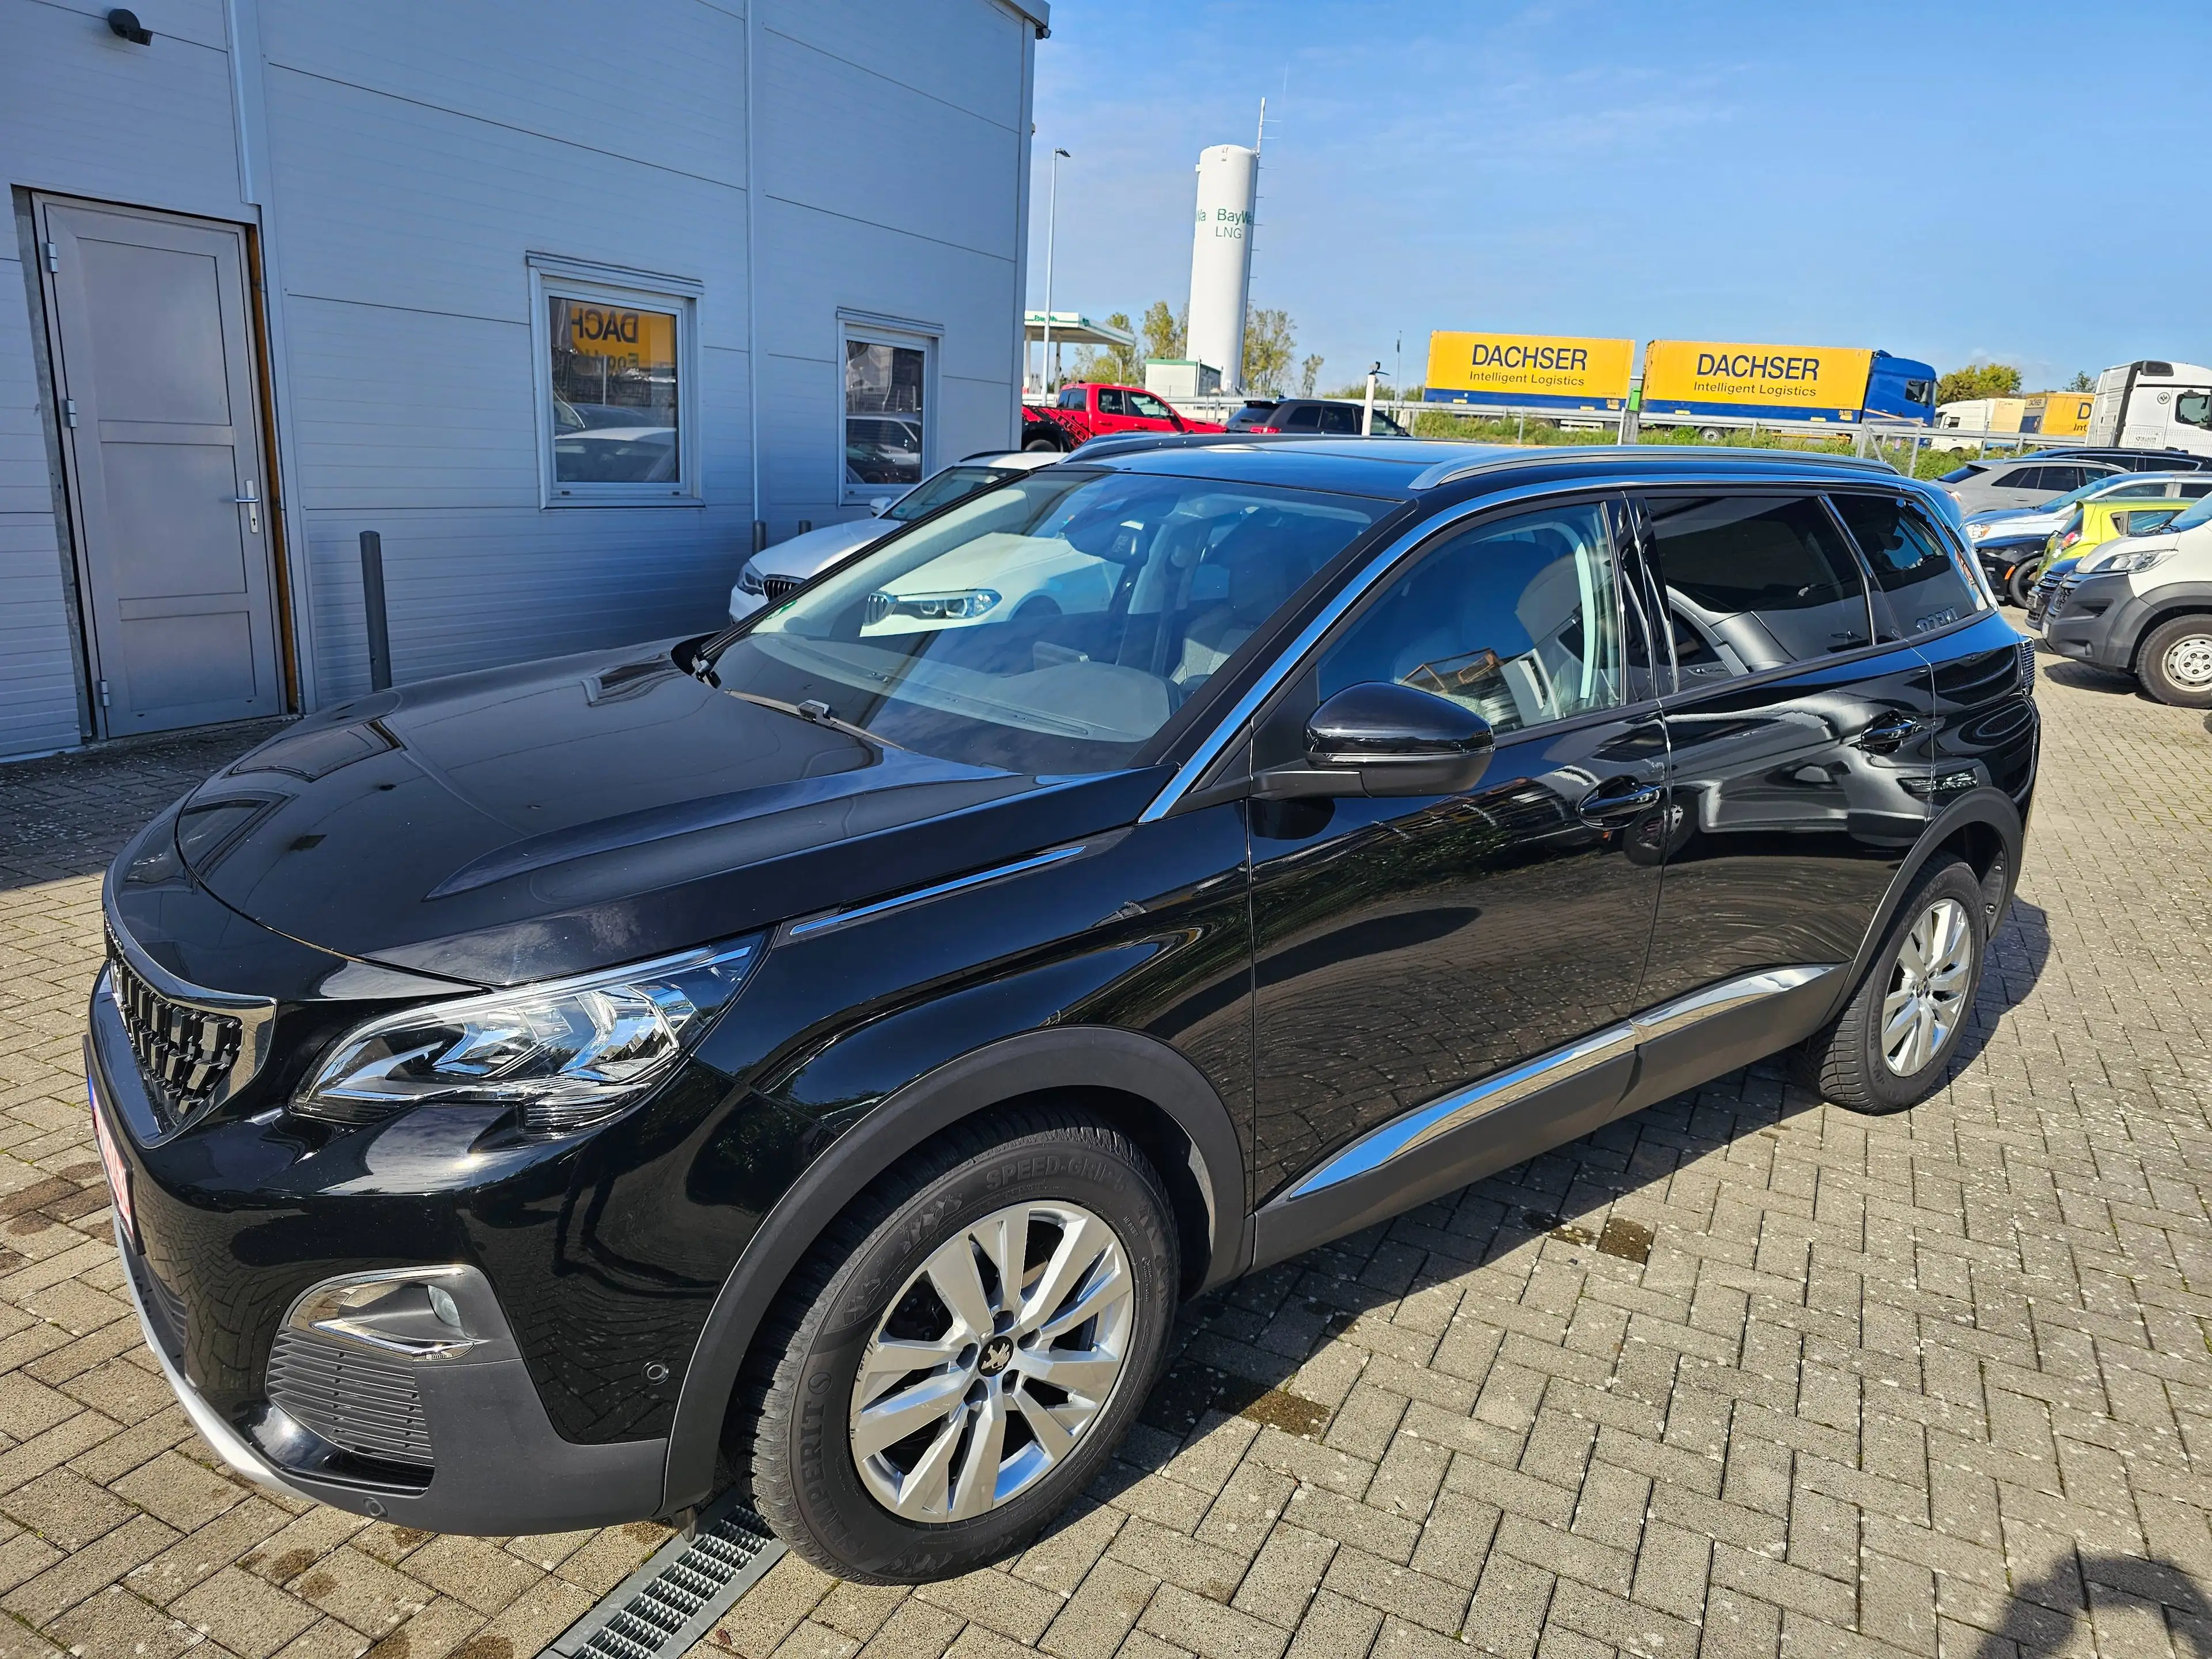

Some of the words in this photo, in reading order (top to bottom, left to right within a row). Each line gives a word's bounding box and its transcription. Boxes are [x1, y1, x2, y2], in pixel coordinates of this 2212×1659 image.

[1215, 226, 1241, 239] LNG
[1472, 344, 1588, 371] DACHSER
[1696, 354, 1820, 381] DACHSER
[1469, 371, 1527, 384] Intelligent
[1531, 374, 1585, 387] Logistics
[1694, 381, 1755, 395] Intelligent
[1759, 385, 1816, 397] Logistics
[800, 1400, 866, 1556] SEMPERIT
